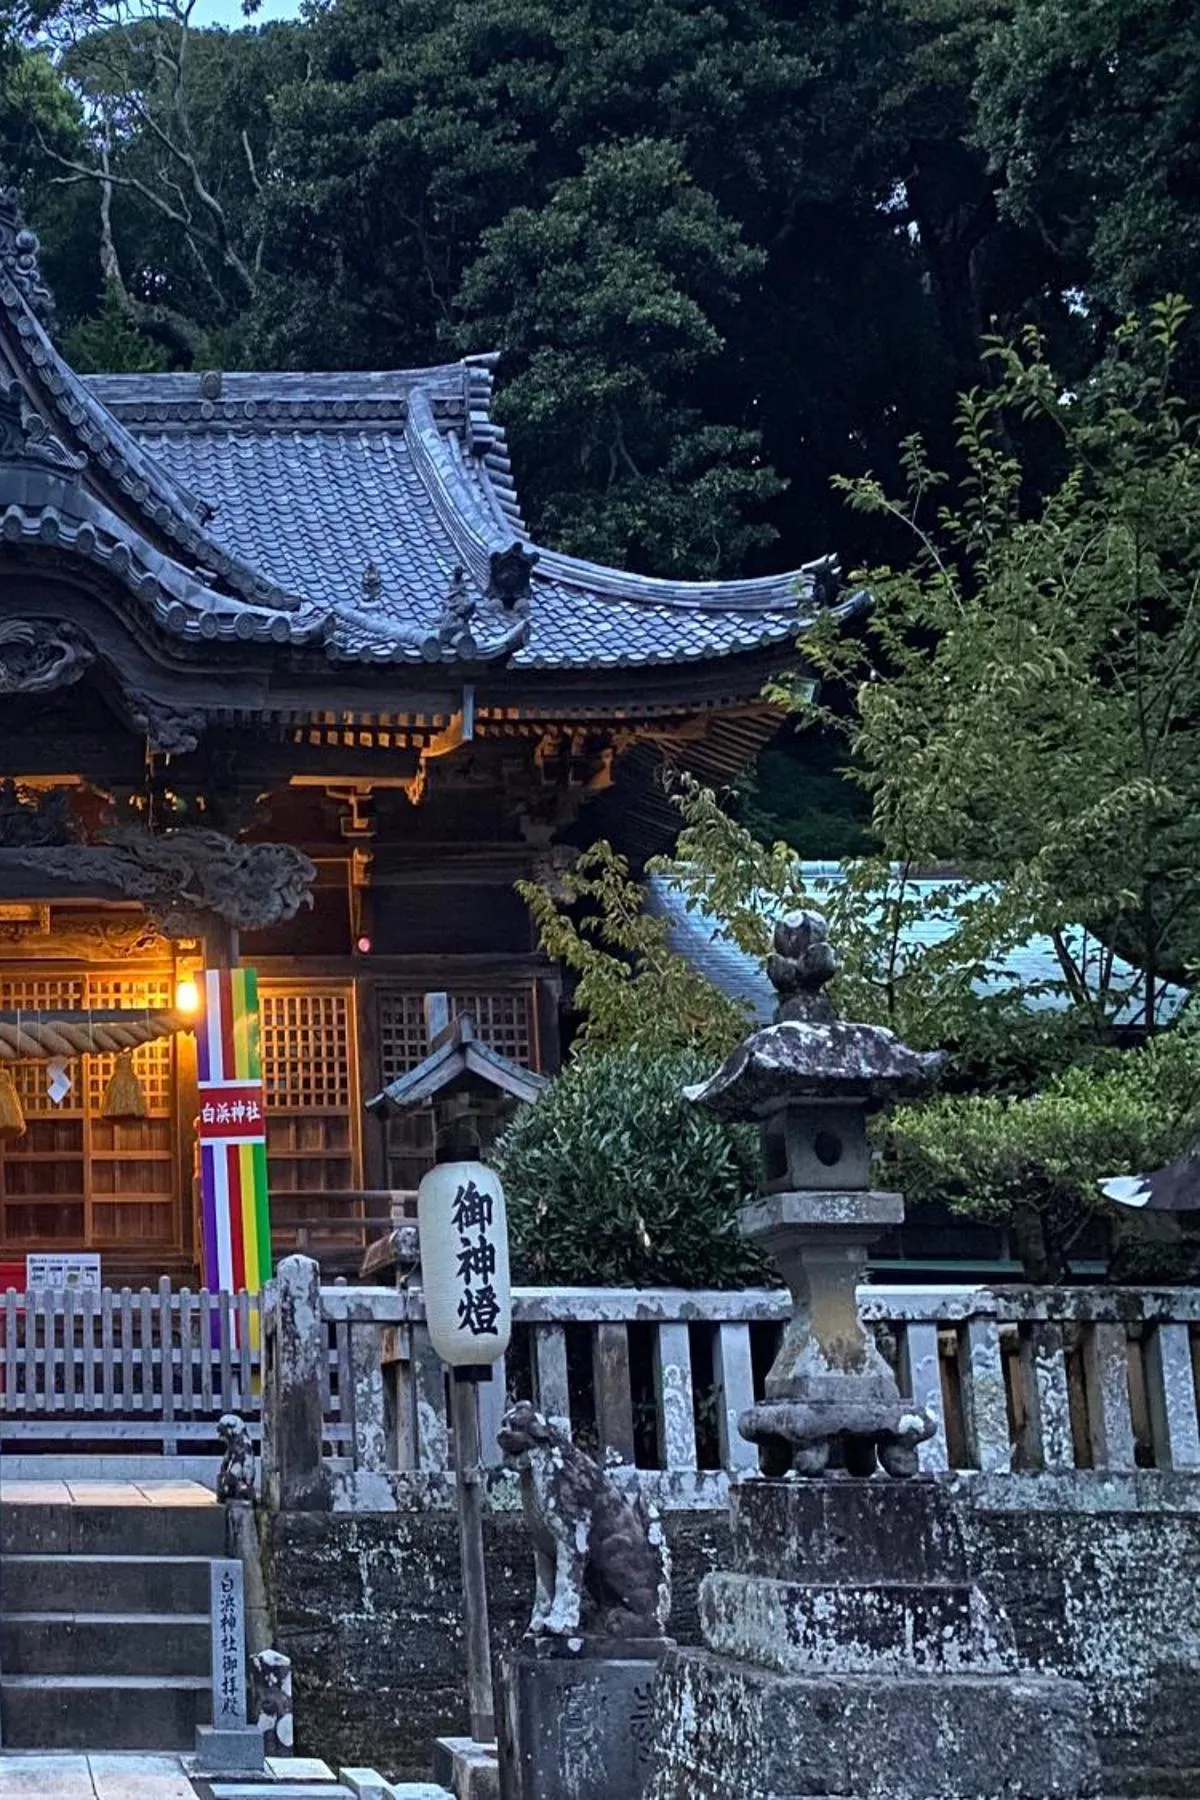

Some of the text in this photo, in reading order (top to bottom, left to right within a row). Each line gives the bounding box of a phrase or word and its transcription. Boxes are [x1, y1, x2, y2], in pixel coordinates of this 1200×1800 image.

[202, 1100, 261, 1124] 白浜神社
[451, 1180, 501, 1336] 御神燈
